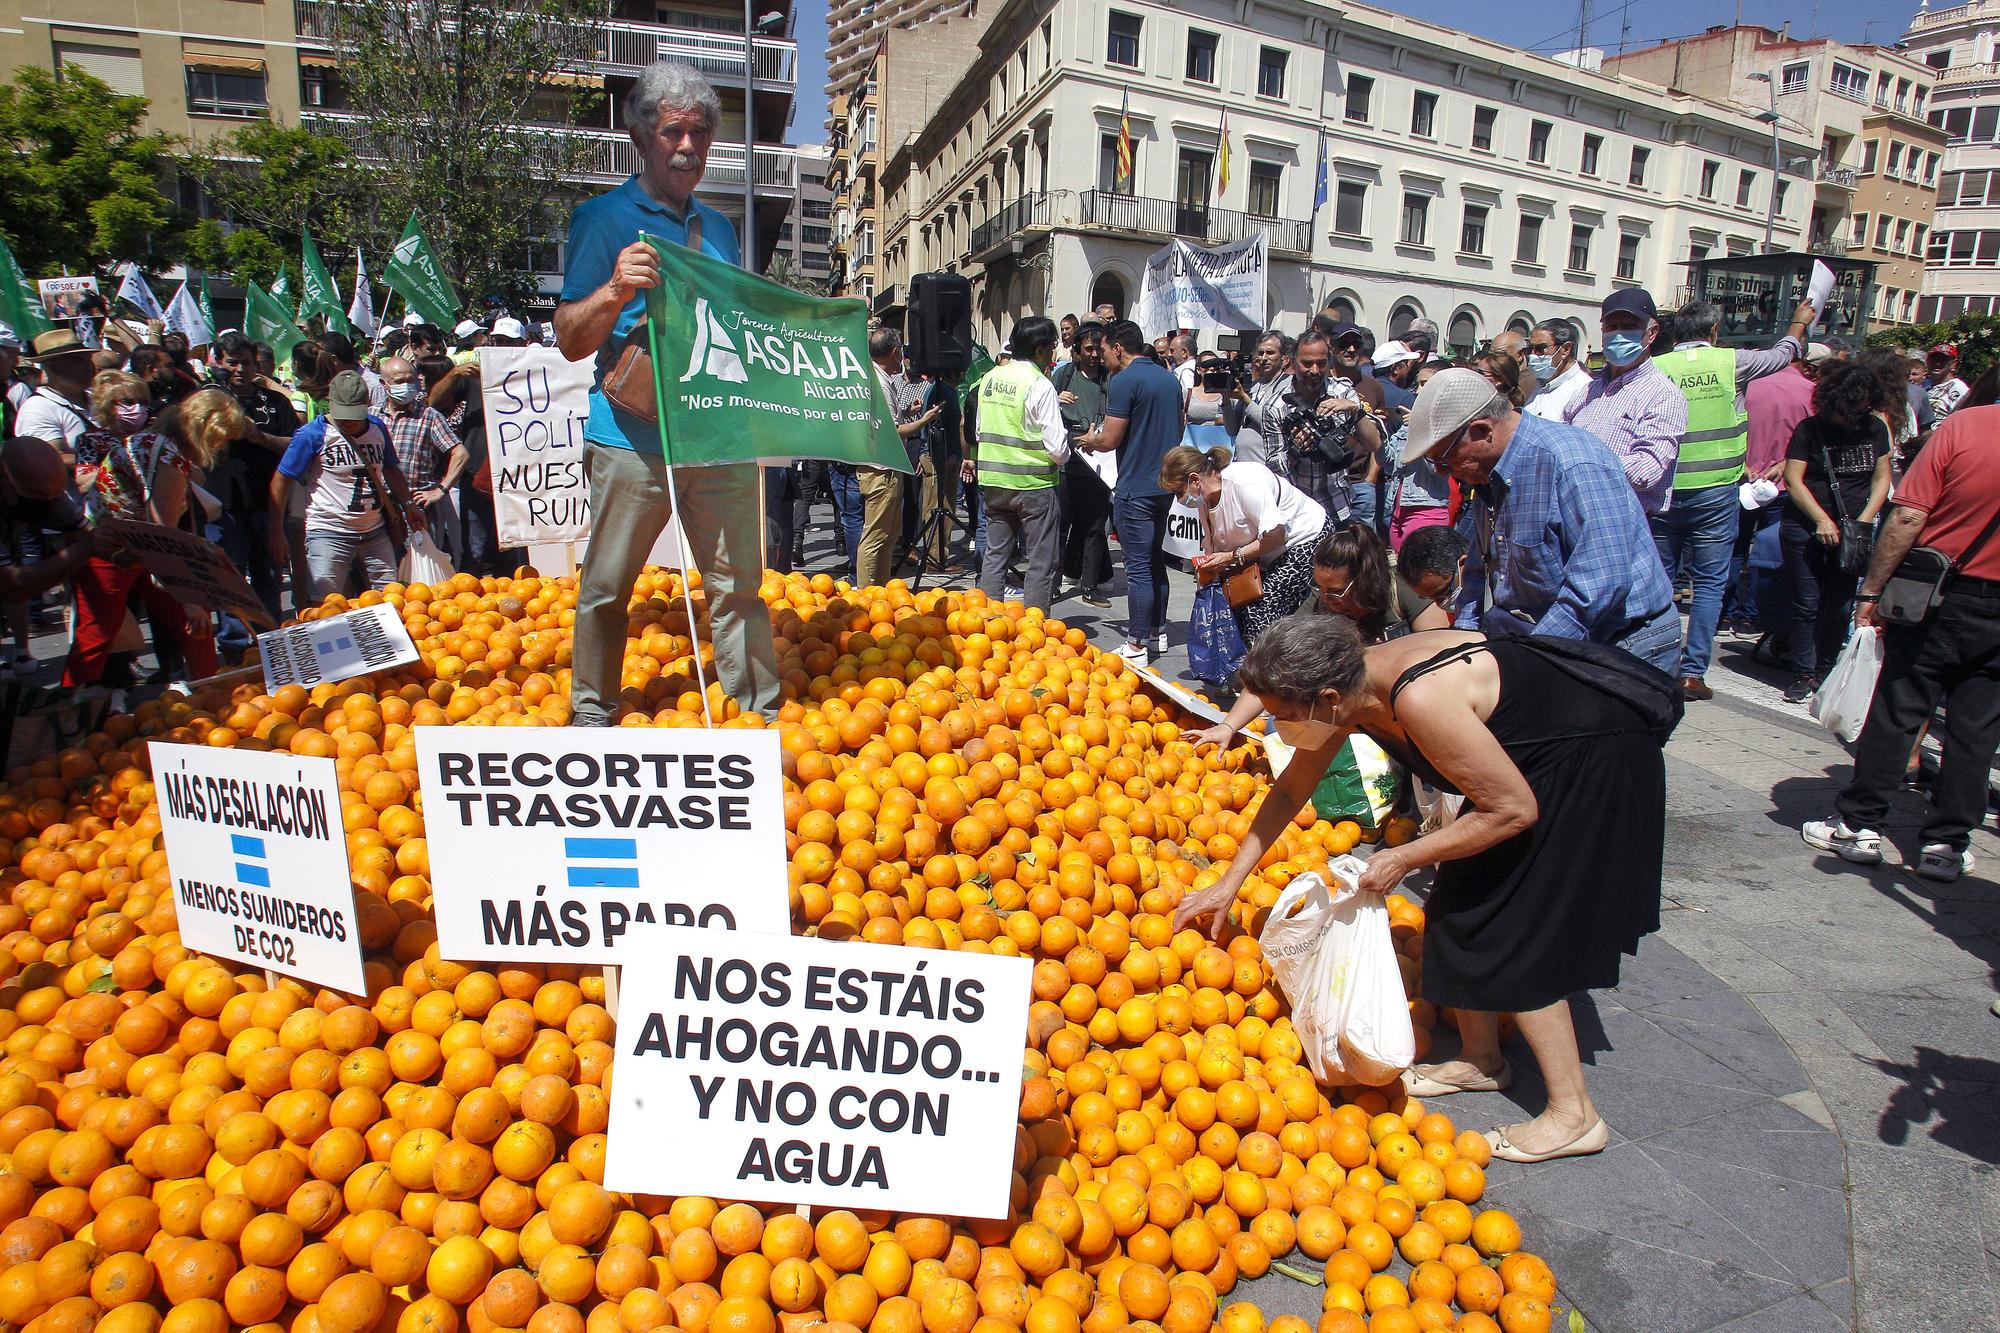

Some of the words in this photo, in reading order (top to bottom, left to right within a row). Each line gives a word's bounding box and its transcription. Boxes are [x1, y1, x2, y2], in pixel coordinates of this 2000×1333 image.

[780, 322, 846, 344] Agricultores
[744, 331, 868, 380] ASAJA
[496, 366, 550, 415] SU
[804, 380, 872, 401] Alicante
[993, 382, 1017, 396] ASAJA
[1680, 373, 1719, 389] ASAJA
[680, 394, 723, 410] "Nos
[729, 395, 800, 417] movemos
[804, 408, 826, 423] por
[831, 409, 843, 422] el
[847, 409, 882, 430] camo"
[324, 445, 358, 466] SAN
[499, 461, 591, 493] NUEST
[291, 640, 323, 685] CONSUMO
[438, 752, 755, 790] RECORTES
[164, 759, 207, 822] MÁS
[206, 770, 330, 841] DESALACIÓN
[446, 793, 752, 830] TRASVASE
[179, 878, 239, 917] MENOS
[240, 891, 347, 942] SUMIDEROS
[480, 885, 591, 947] MÁS
[234, 924, 258, 957] DE
[259, 930, 297, 967] CO2
[674, 955, 792, 1008] NOS
[804, 961, 985, 1024] ESTÁIS
[633, 1012, 1000, 1084] AHOGANDO...
[689, 1075, 726, 1119] Y
[735, 1078, 817, 1126] NO
[829, 1086, 950, 1137] CON
[736, 1137, 889, 1190] AGUA
